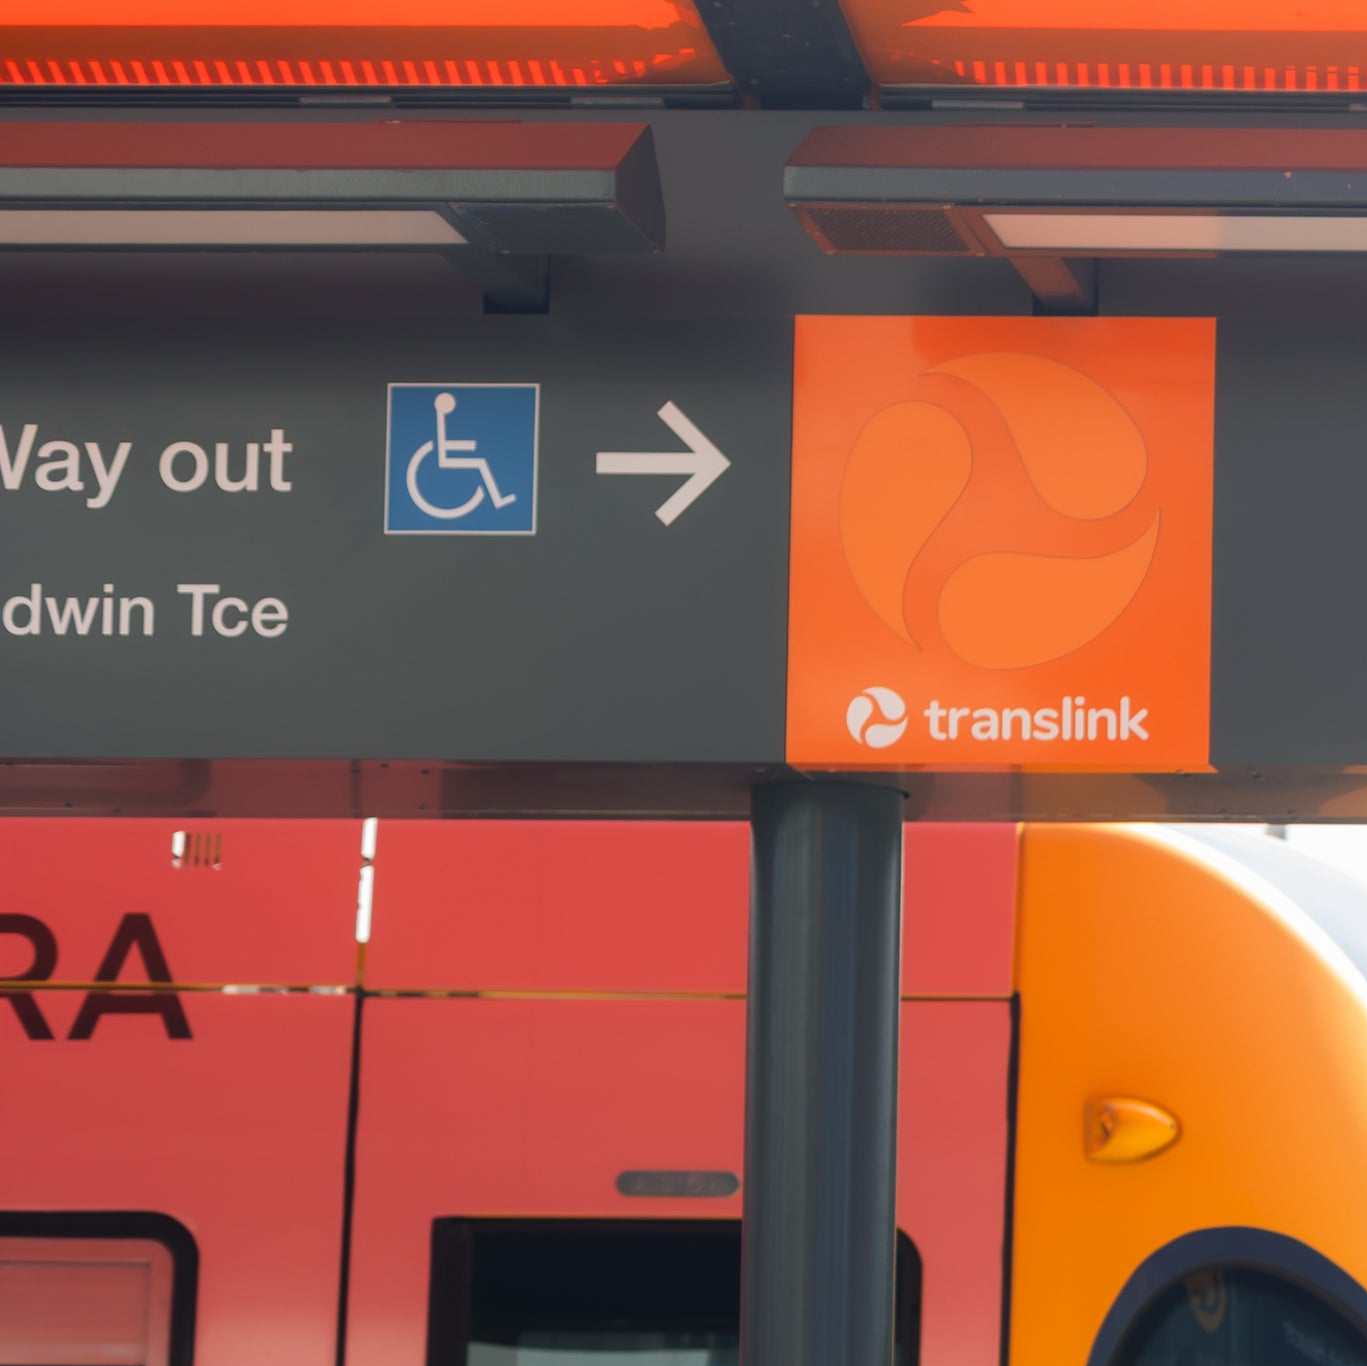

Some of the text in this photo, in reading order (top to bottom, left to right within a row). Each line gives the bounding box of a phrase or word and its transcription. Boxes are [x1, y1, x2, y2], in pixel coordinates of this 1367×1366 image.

[159, 429, 293, 492] out
[2, 583, 289, 637] dwin Tce
[923, 695, 1149, 741] translink
[0, 912, 194, 1041] RA
